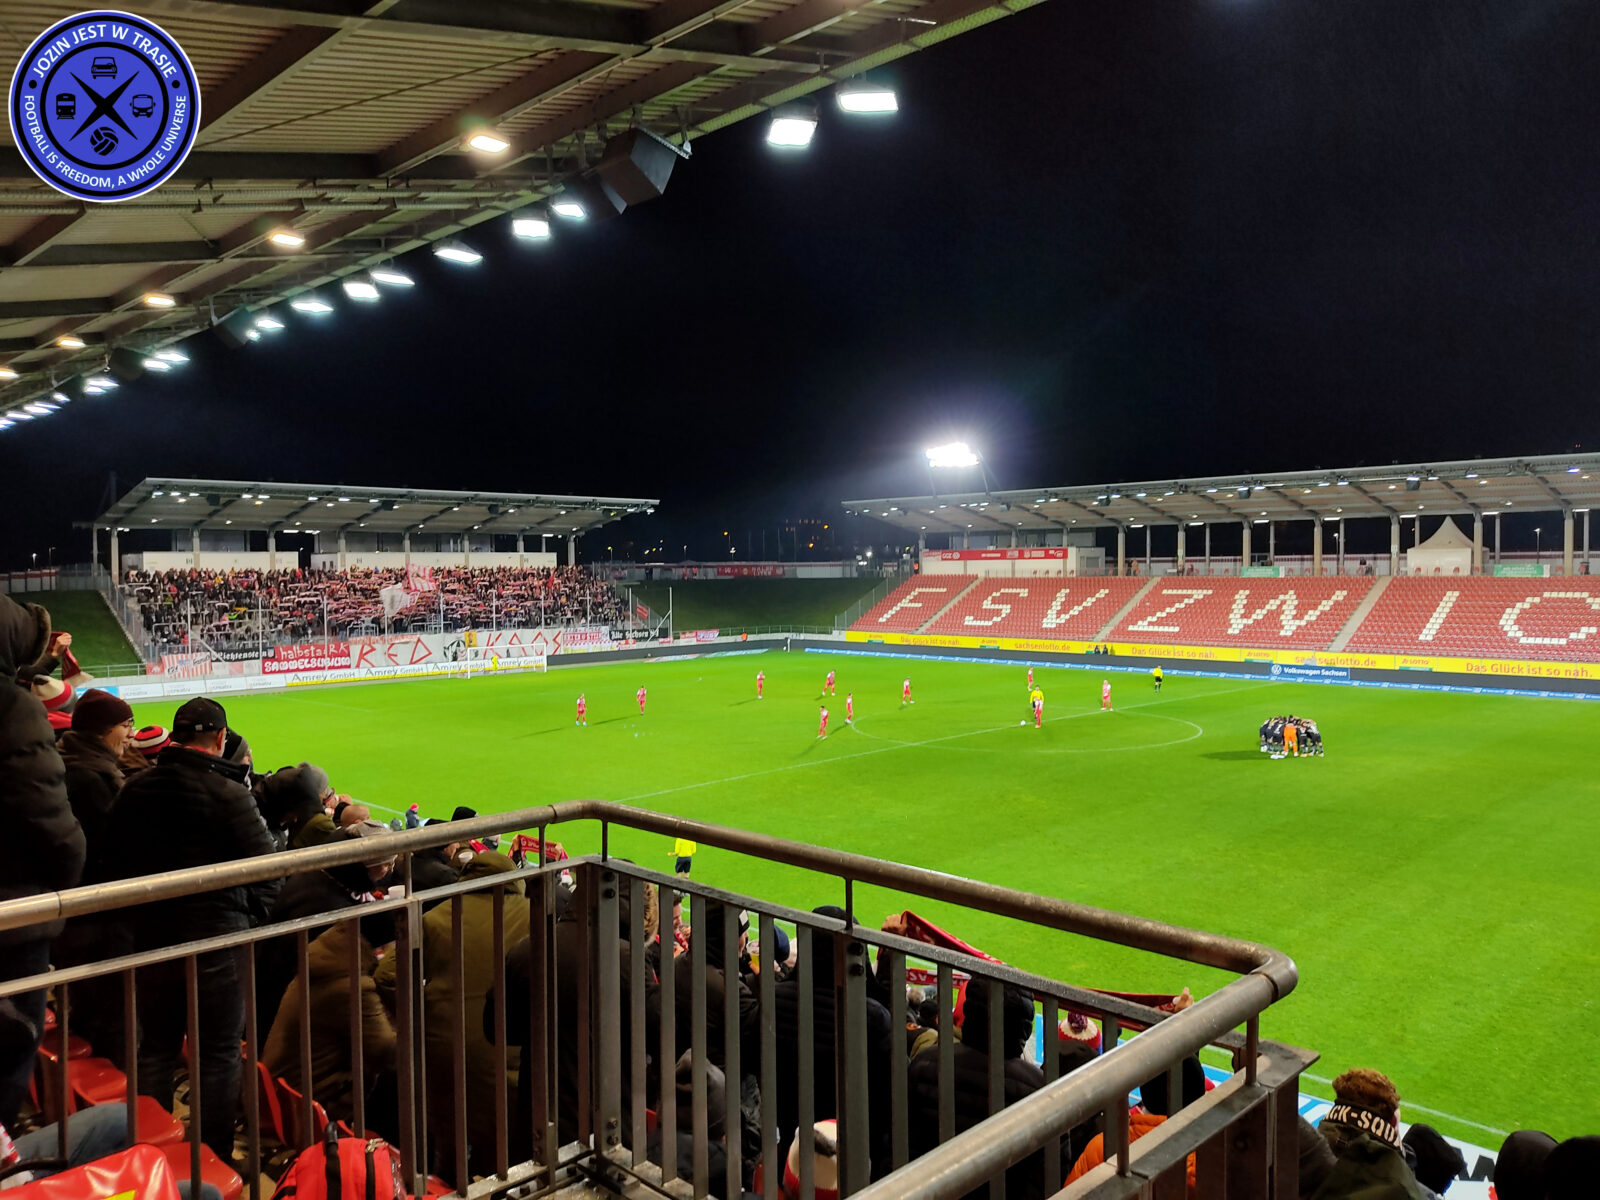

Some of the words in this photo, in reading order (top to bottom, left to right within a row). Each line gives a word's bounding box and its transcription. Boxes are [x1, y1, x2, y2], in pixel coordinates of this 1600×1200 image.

[356, 638, 432, 667] RED
[1014, 642, 1071, 652] sachsenlotto.de
[216, 650, 267, 661] Lichtensten
[1131, 647, 1147, 656] Das
[1149, 647, 1171, 657] Glück
[1186, 651, 1197, 659] so
[366, 667, 398, 678] Amrey
[1283, 667, 1320, 677] Volkswagen
[1466, 662, 1487, 673] Das
[1490, 662, 1524, 676] Glück
[1527, 663, 1543, 675] ist
[1546, 667, 1561, 676] so
[292, 673, 328, 683] Amrey
[330, 671, 355, 679] GmbH
